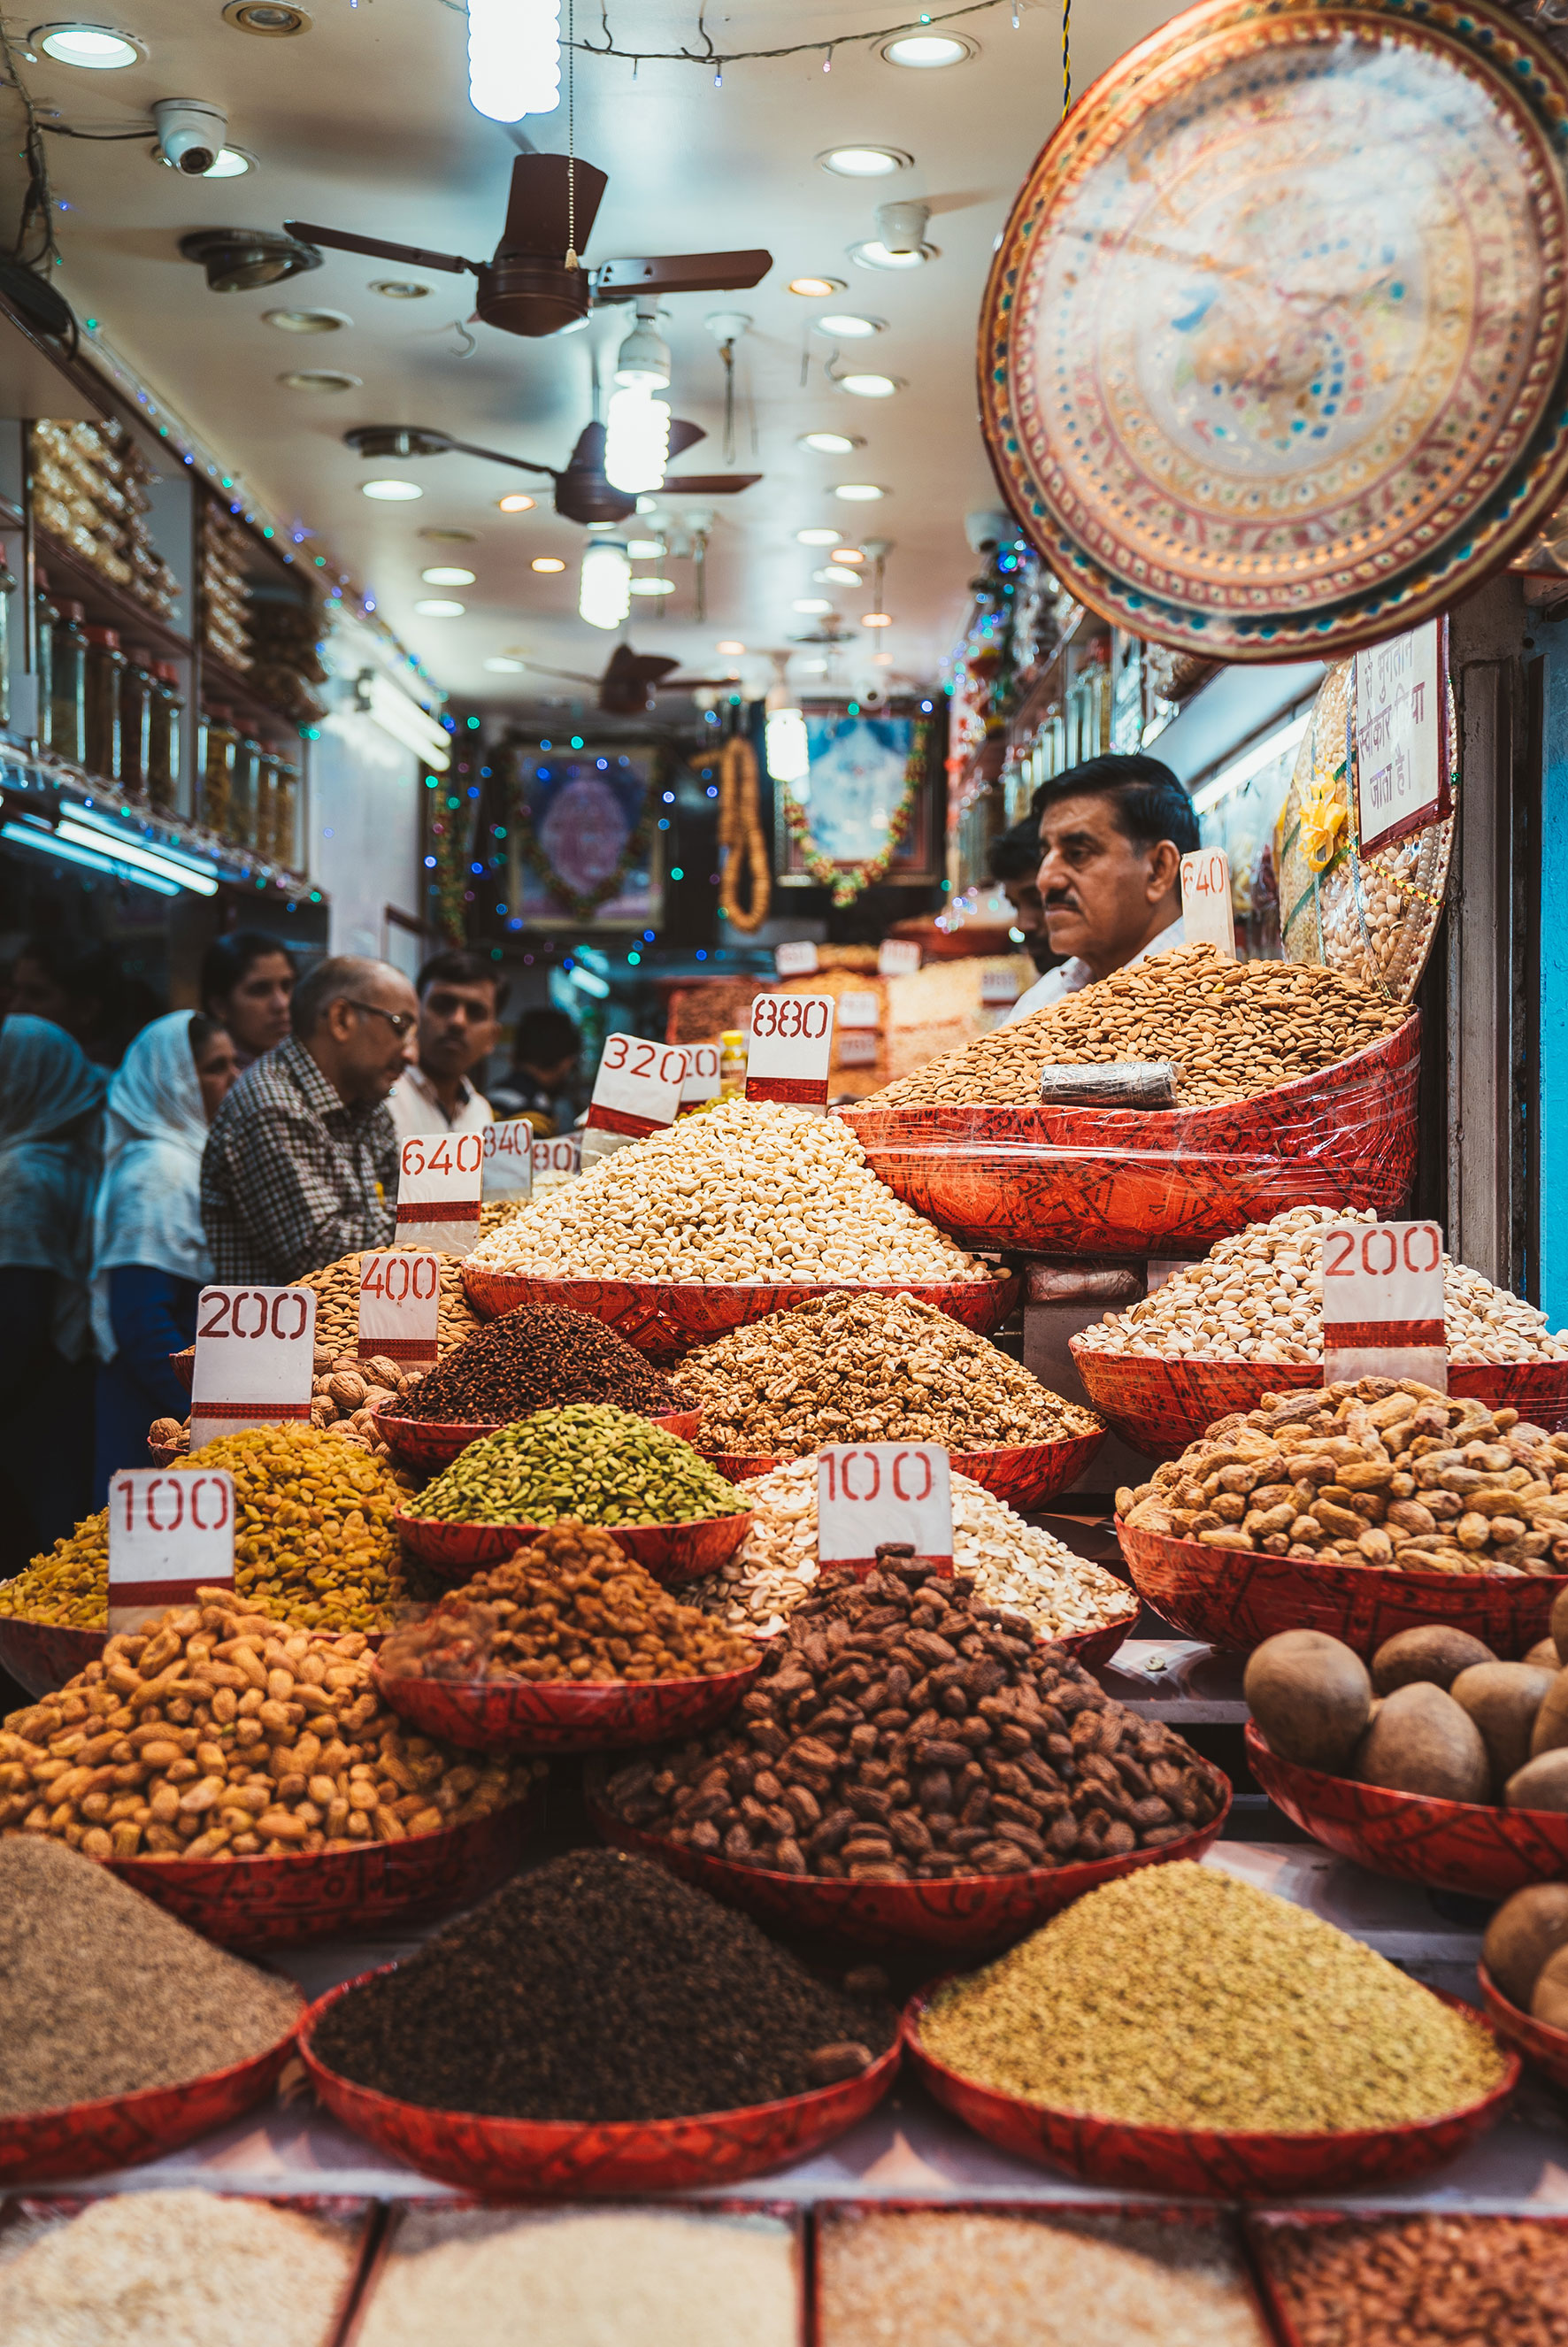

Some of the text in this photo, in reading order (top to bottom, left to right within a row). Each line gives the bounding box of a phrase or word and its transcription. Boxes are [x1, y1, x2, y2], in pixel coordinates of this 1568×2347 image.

[1358, 703, 1392, 764] स्वीकार
[1370, 762, 1392, 811] जाता
[753, 999, 828, 1039] 880
[603, 1037, 688, 1084] 320
[402, 1135, 483, 1175] 640
[482, 1122, 530, 1158] 840
[1326, 1226, 1441, 1276] 200
[360, 1257, 436, 1300] 400
[198, 1291, 308, 1340] 200
[819, 1451, 933, 1502] 100
[118, 1477, 228, 1532] 100
